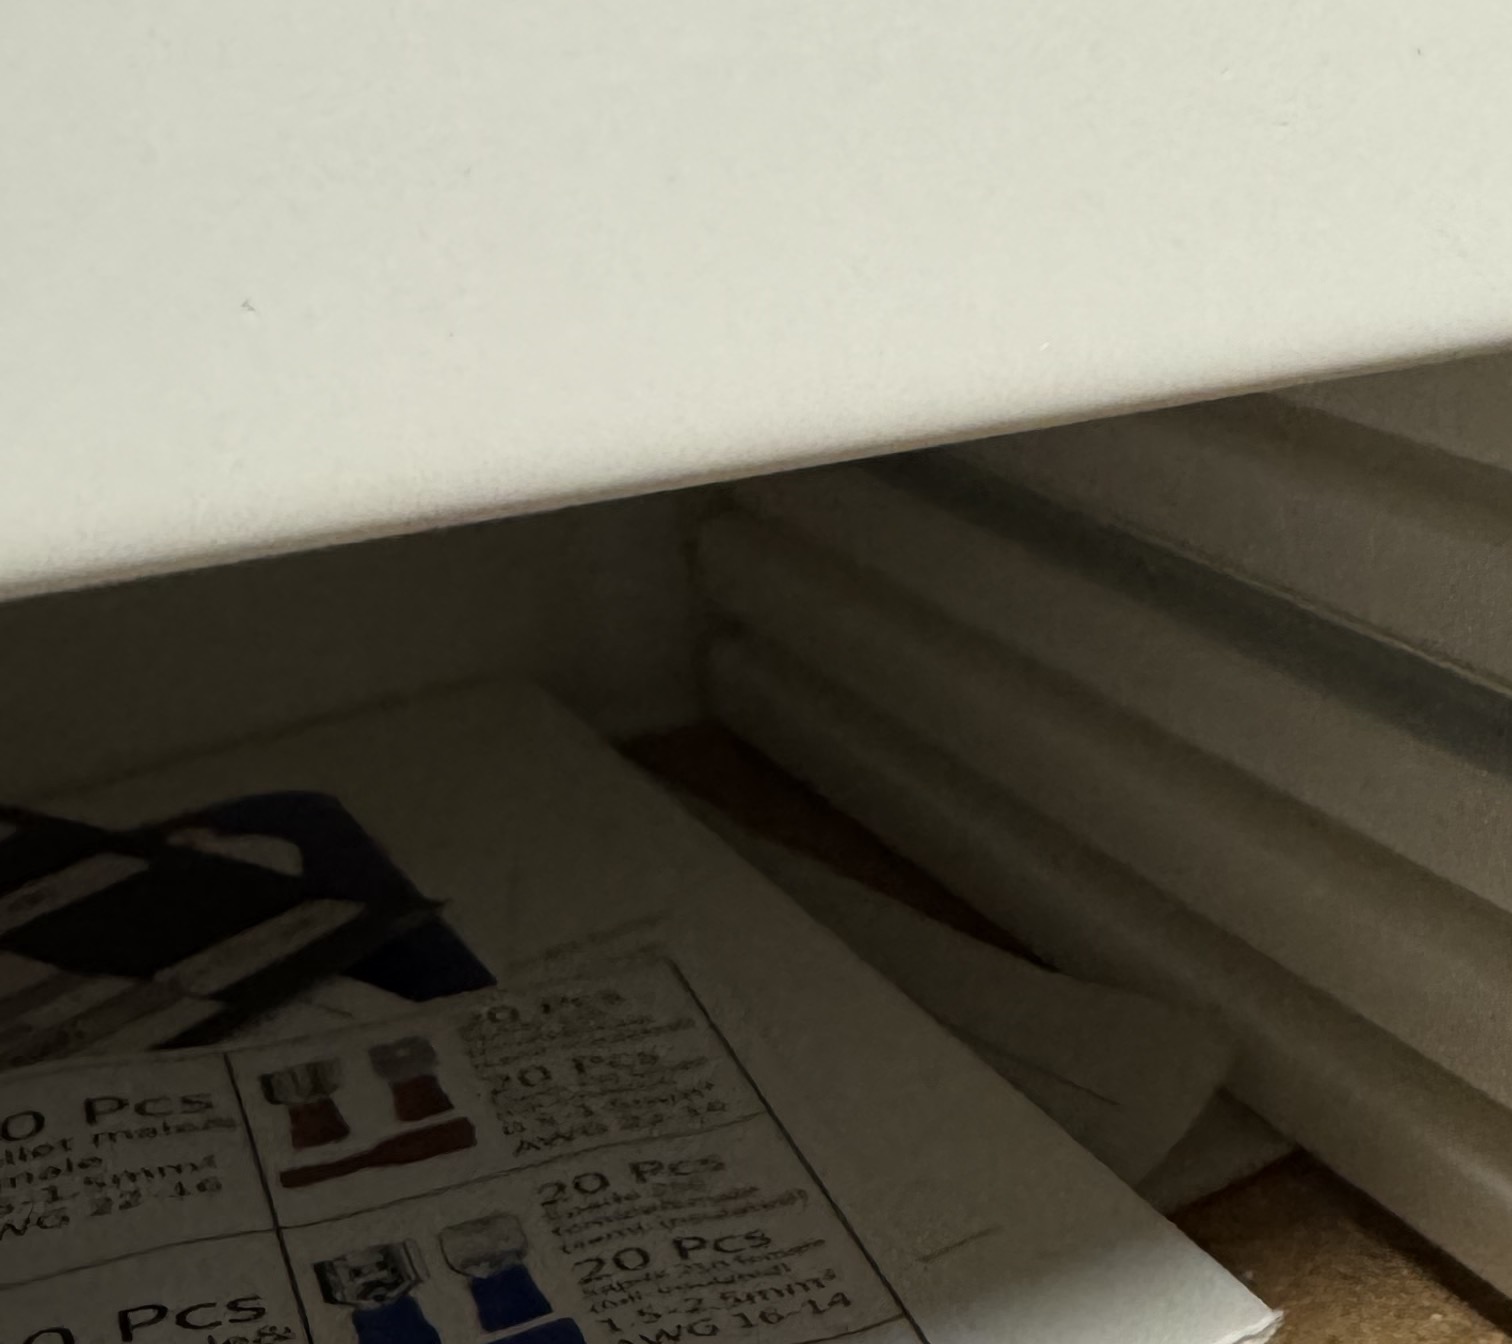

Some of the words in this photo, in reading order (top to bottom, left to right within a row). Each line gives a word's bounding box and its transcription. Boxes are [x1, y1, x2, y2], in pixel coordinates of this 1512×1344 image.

[84, 1092, 214, 1126] Pcs
[537, 1171, 611, 1207] 20
[628, 1155, 727, 1184] Pcs
[573, 1247, 651, 1285] 20
[671, 1229, 772, 1261] Pcs
[117, 1294, 266, 1343] Pcs
[732, 1291, 852, 1330] 16-14
